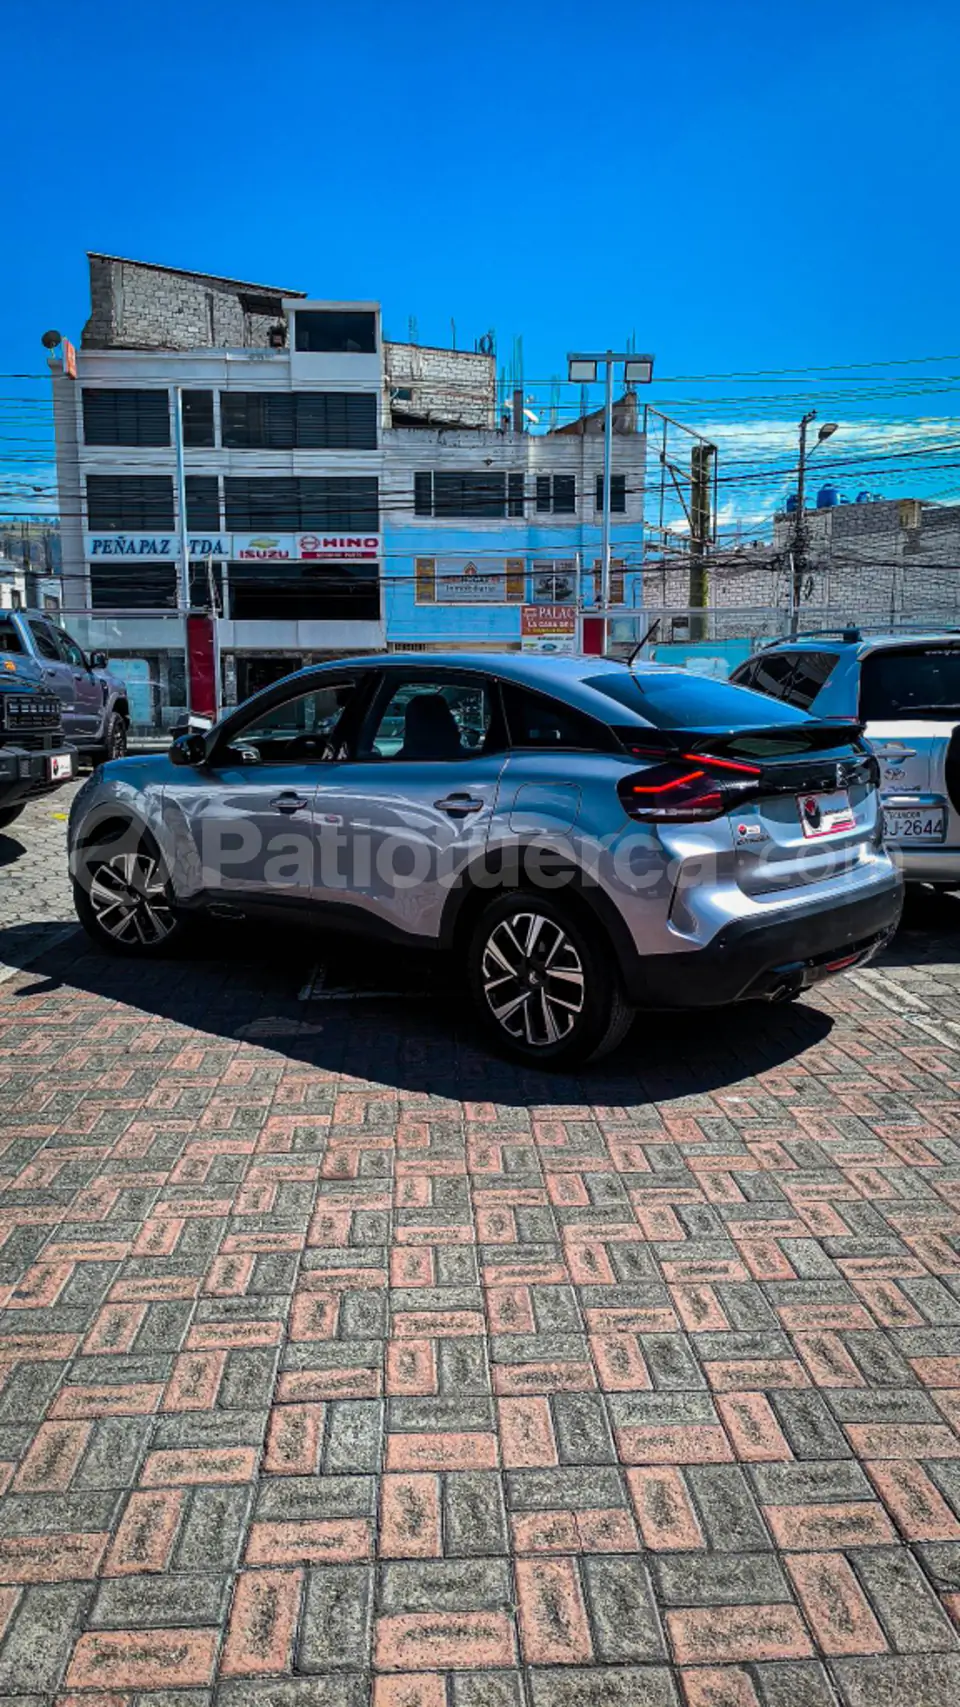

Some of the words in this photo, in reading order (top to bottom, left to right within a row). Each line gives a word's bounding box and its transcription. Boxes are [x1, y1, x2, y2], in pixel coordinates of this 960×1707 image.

[92, 536, 171, 555] PEÑAPAZ
[322, 538, 379, 548] HINO
[239, 549, 289, 559] ISUZU
[539, 606, 575, 619] PALAC
